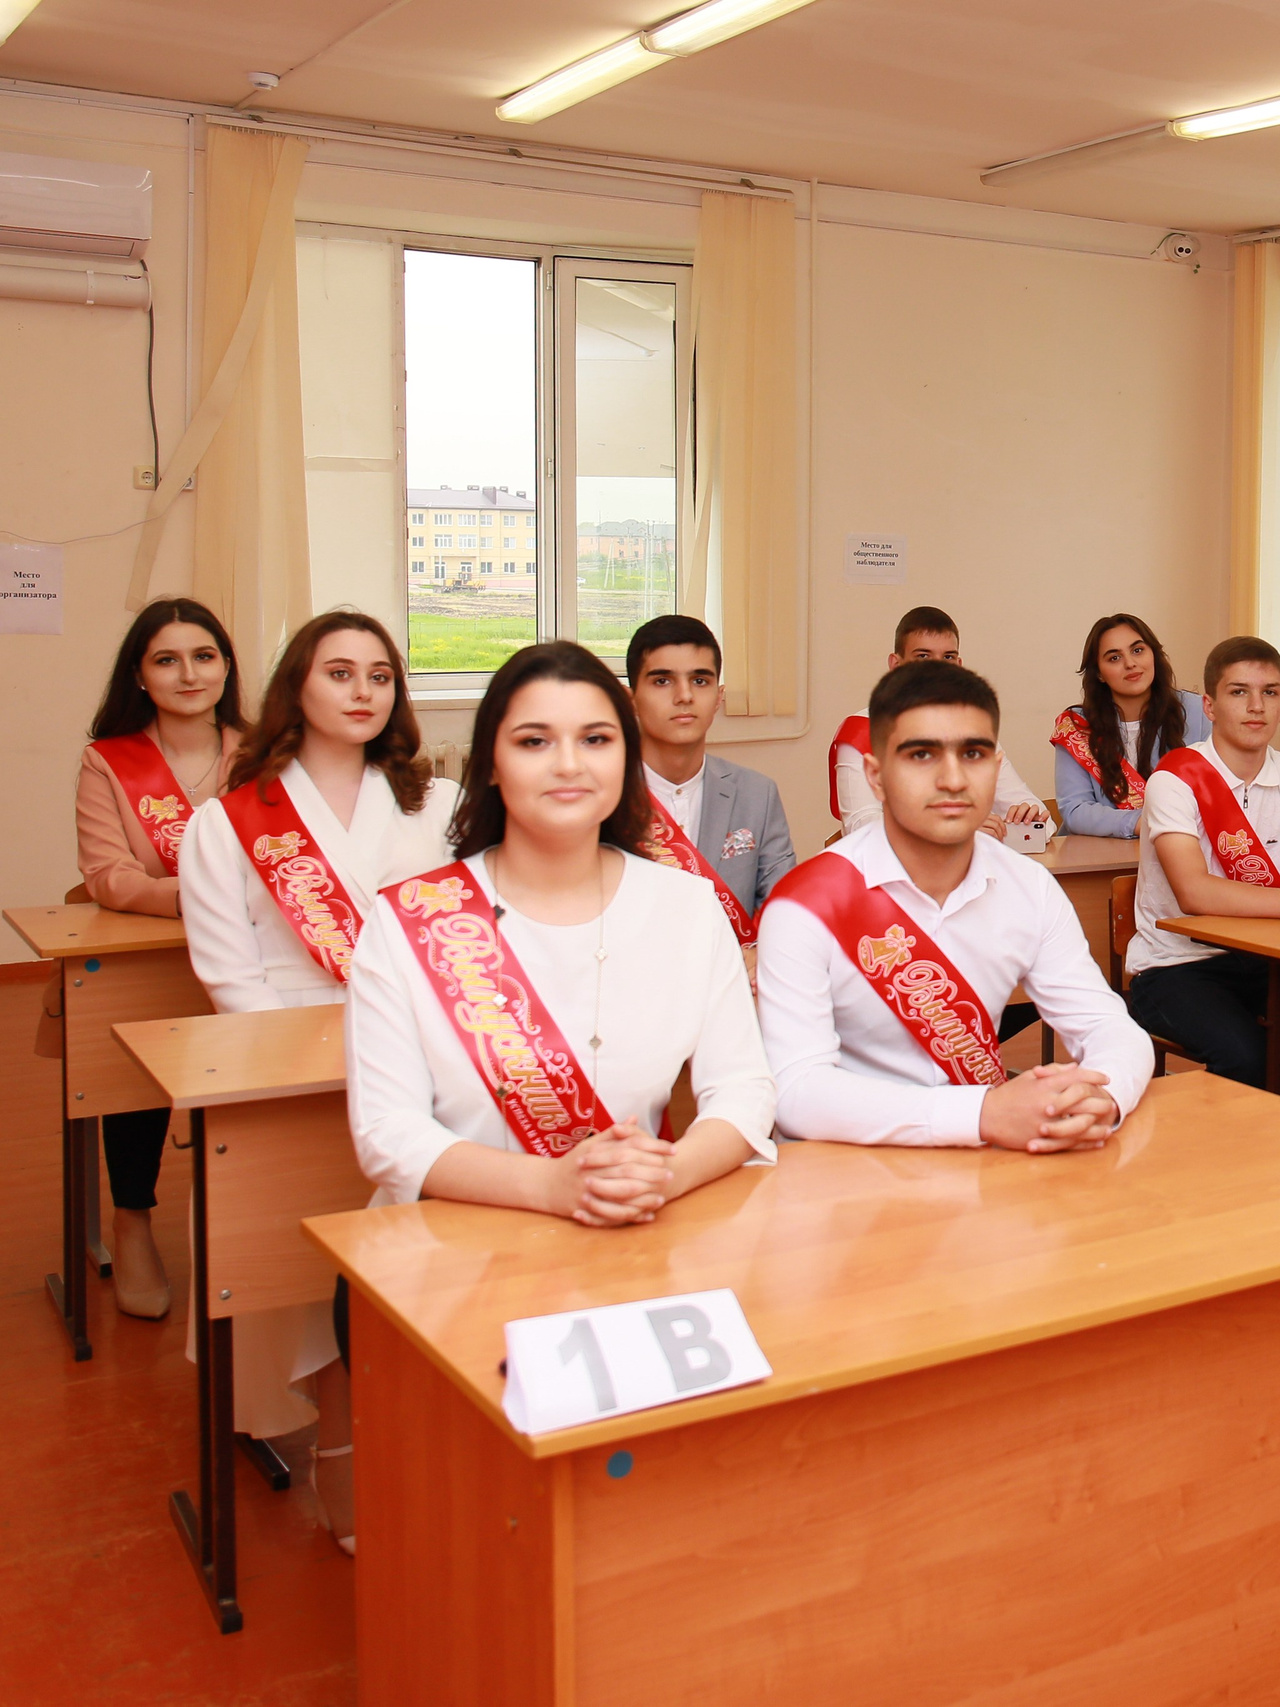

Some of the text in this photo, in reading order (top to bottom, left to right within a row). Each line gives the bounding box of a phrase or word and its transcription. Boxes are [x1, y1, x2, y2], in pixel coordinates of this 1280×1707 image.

[14, 571, 41, 579] Место
[853, 550, 899, 558] общественного
[856, 559, 896, 567] наблюдателя
[276, 855, 354, 980] Выпус
[893, 959, 1005, 1087] Выпускн
[558, 1304, 732, 1412] 1 В
